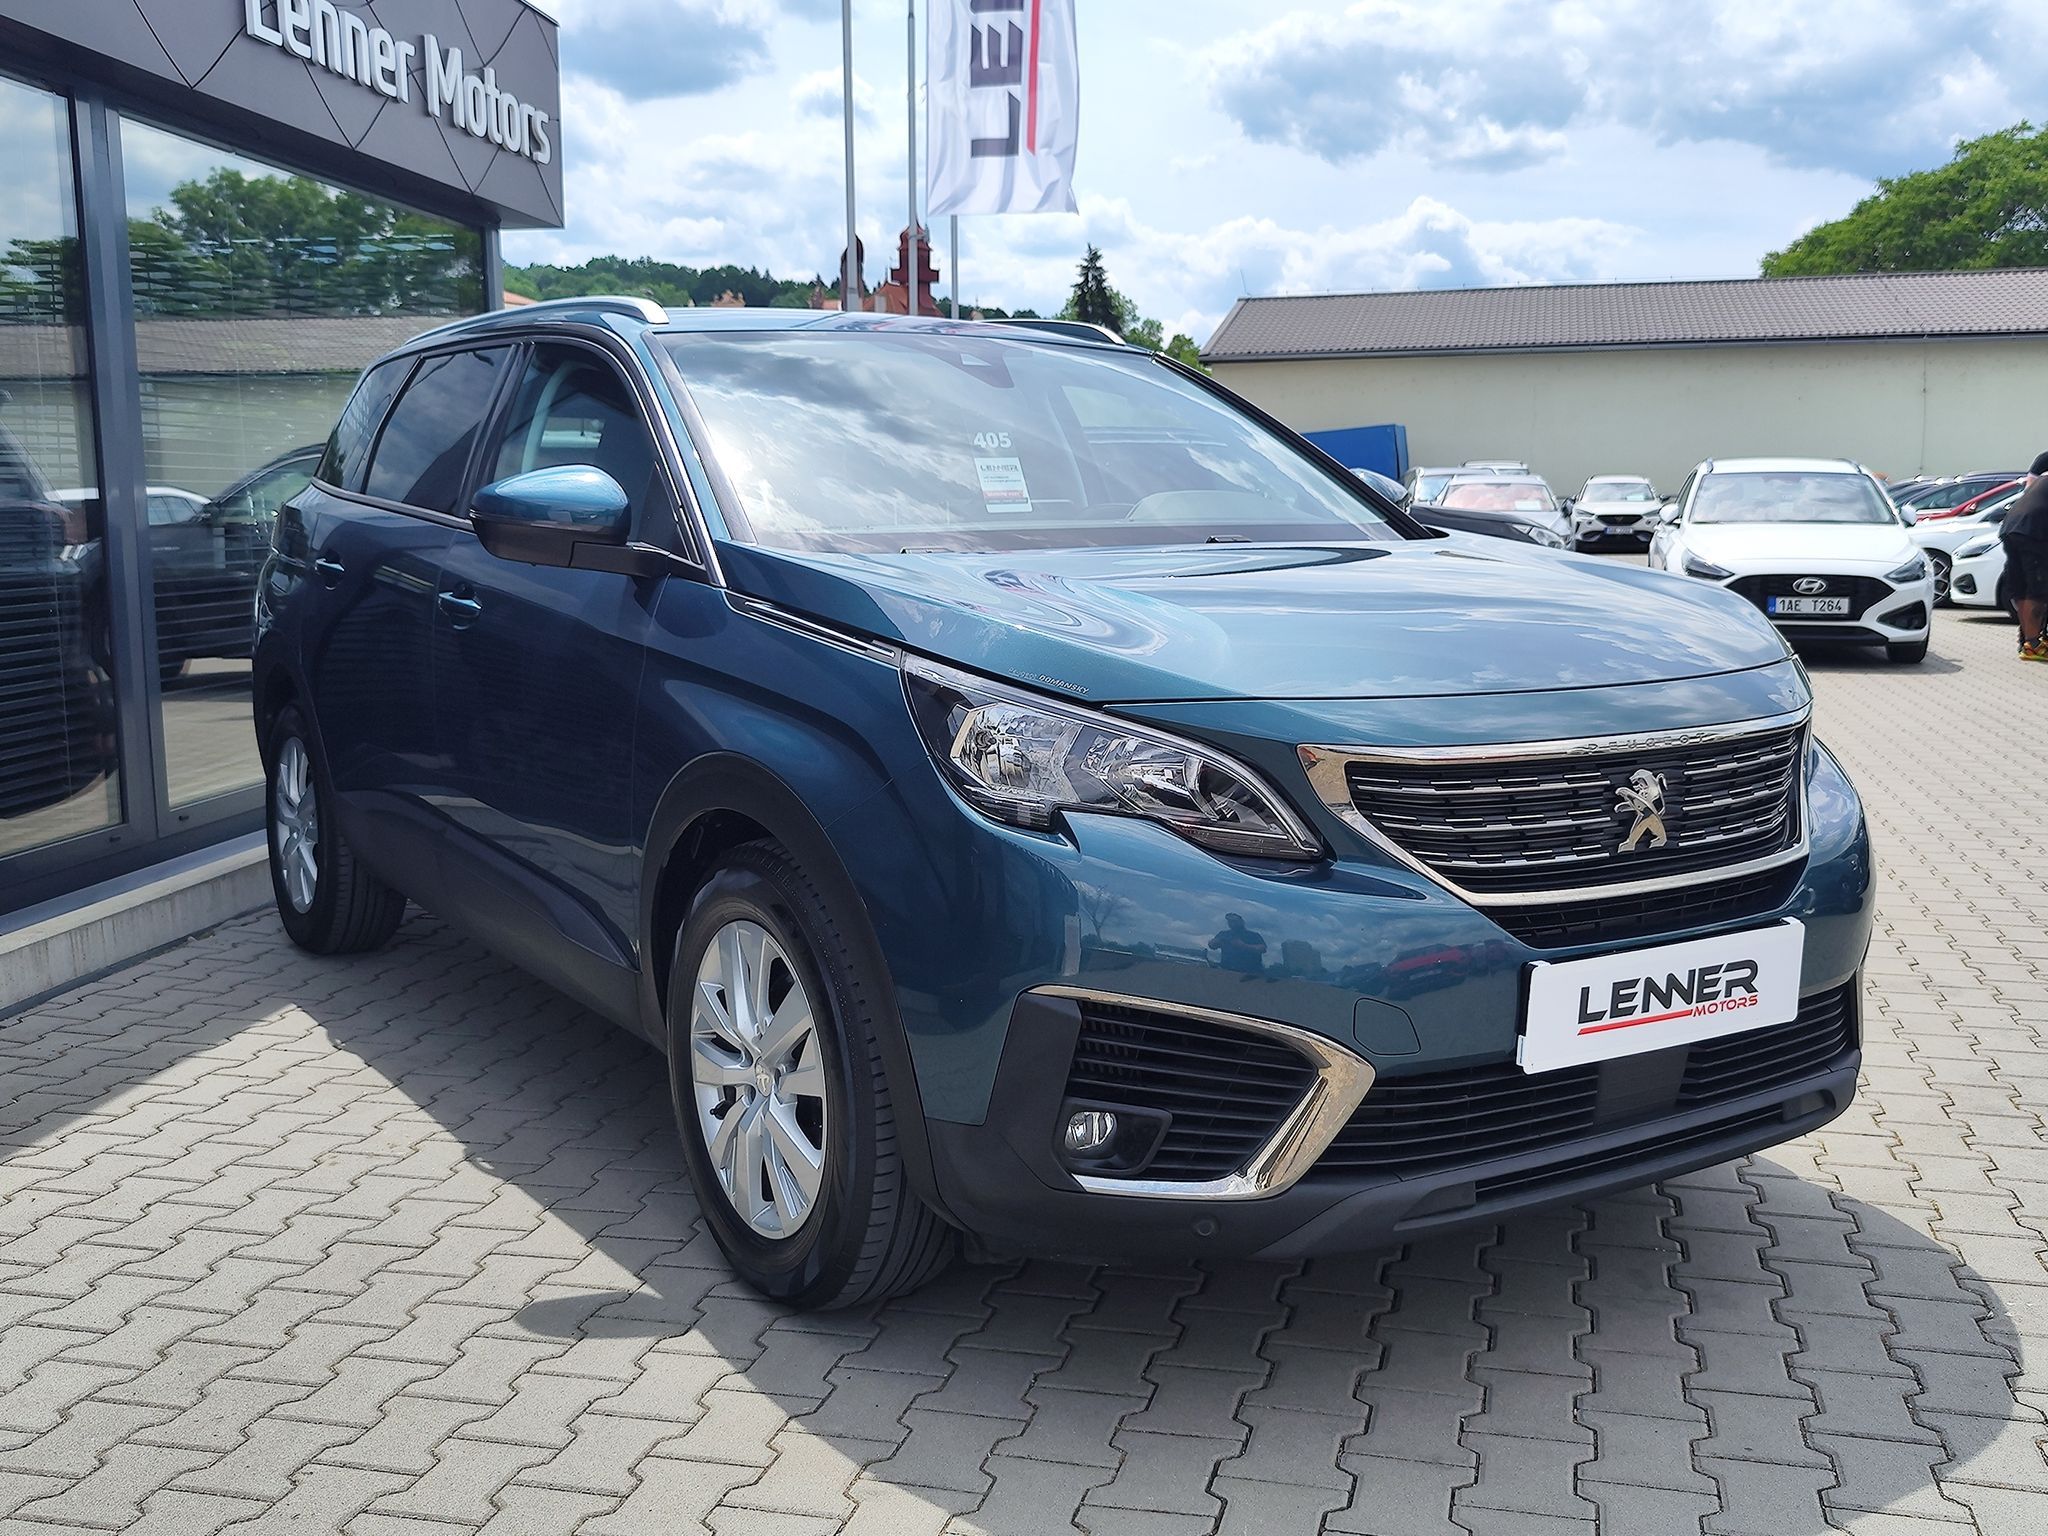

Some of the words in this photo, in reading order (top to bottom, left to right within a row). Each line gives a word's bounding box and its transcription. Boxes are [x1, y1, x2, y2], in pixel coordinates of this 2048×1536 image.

[244, 0, 416, 104] Lenner
[422, 34, 552, 166] Motors
[969, 0, 1024, 159] LE
[973, 431, 1012, 449] 405
[1779, 599, 1802, 612] 1AE
[1811, 599, 1842, 612] T264
[1577, 958, 1760, 1025] LENNER
[1691, 994, 1759, 1018] MOTORS
